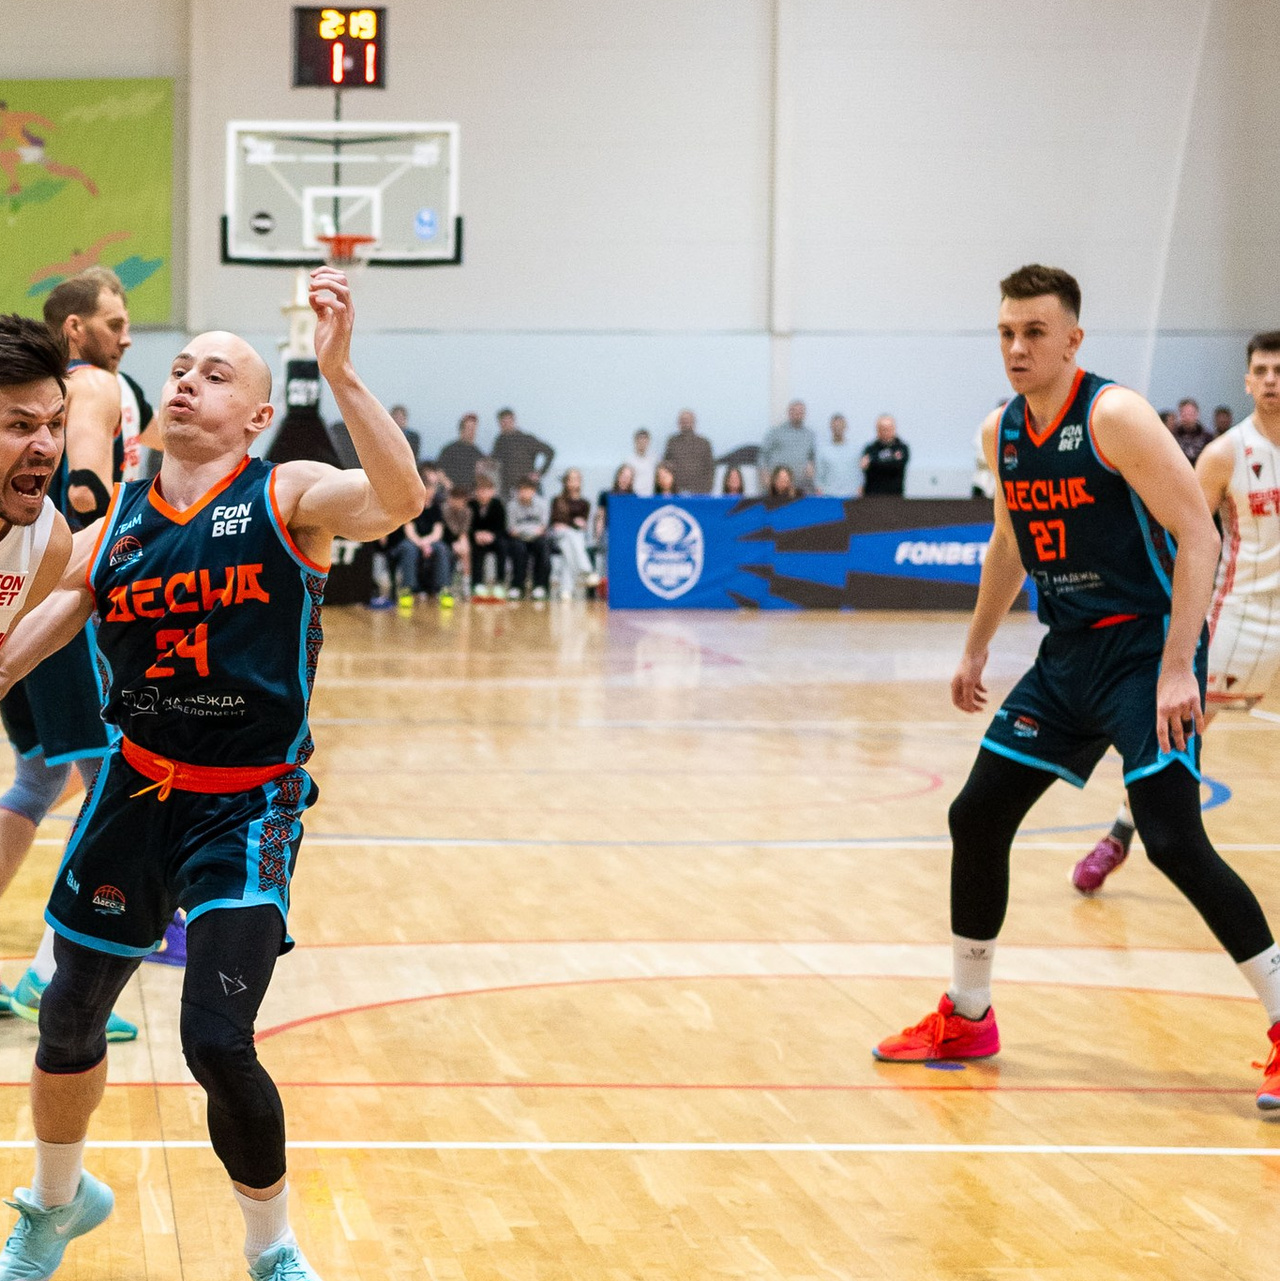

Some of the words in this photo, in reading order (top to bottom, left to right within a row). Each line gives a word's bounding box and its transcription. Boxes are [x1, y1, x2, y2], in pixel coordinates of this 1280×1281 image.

[1057, 437, 1083, 452] BET
[212, 502, 253, 522] FON
[211, 517, 252, 538] BET
[1028, 518, 1067, 562] 27
[145, 622, 210, 679] 24
